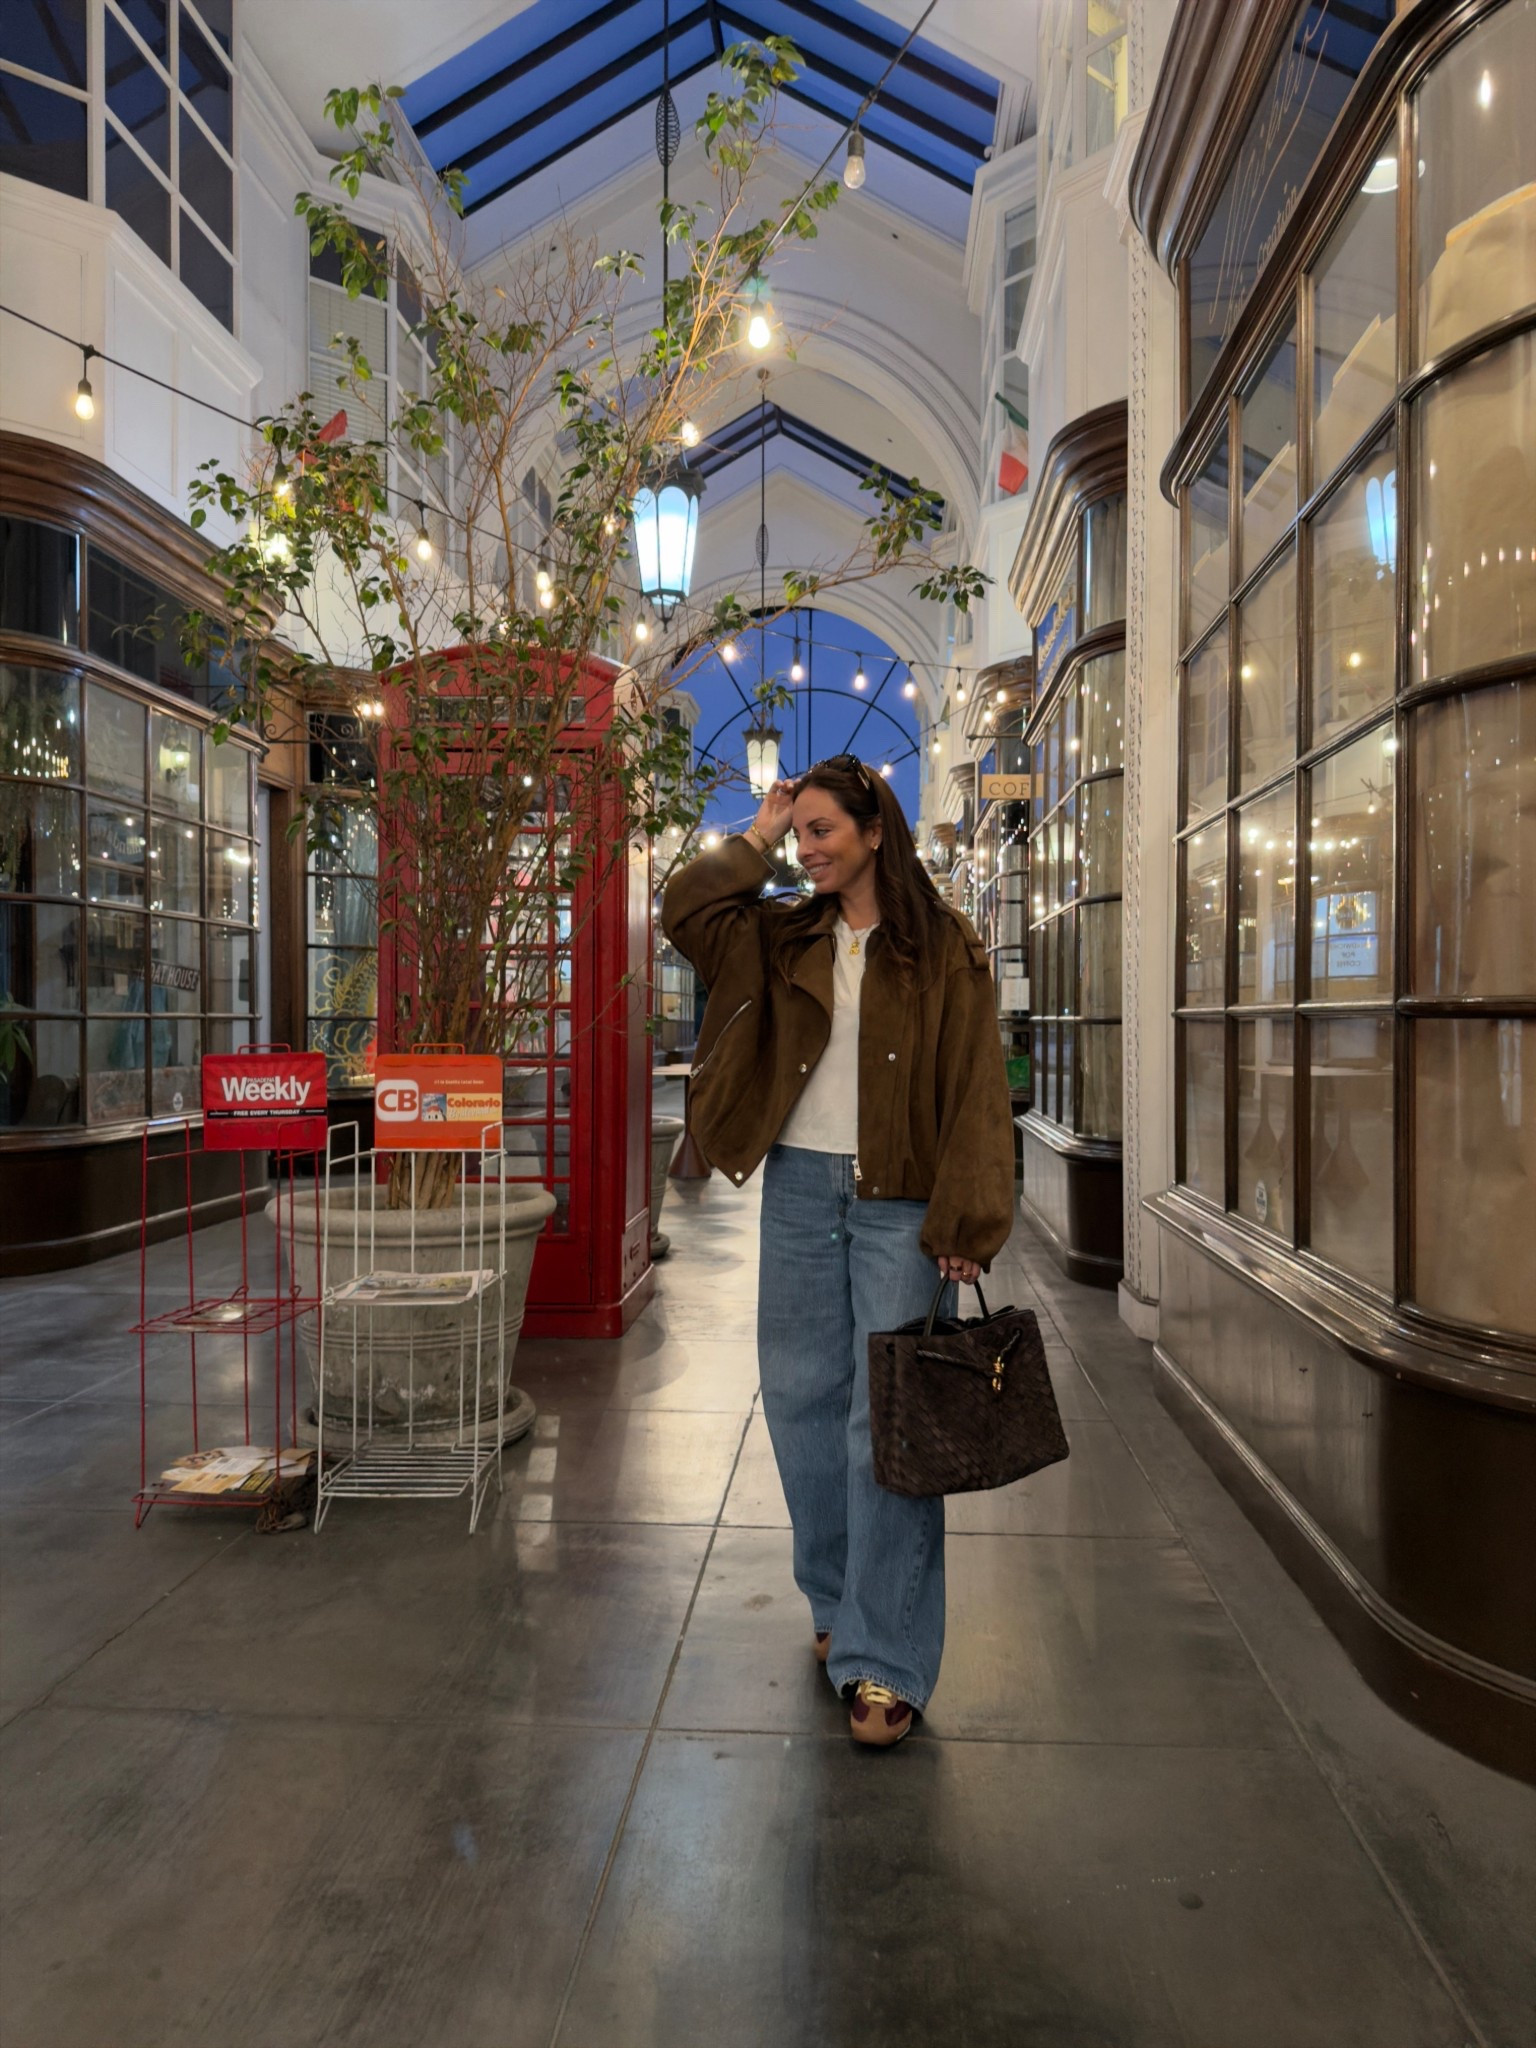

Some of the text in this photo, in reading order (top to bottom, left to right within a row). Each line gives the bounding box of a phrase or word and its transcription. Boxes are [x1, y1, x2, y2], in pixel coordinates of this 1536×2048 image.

[167, 966, 198, 989] HOUSE
[221, 1075, 311, 1106] Weekly
[378, 1088, 417, 1112] CB
[269, 1108, 300, 1116] THURSDAY
[447, 1097, 501, 1108] Colorado
